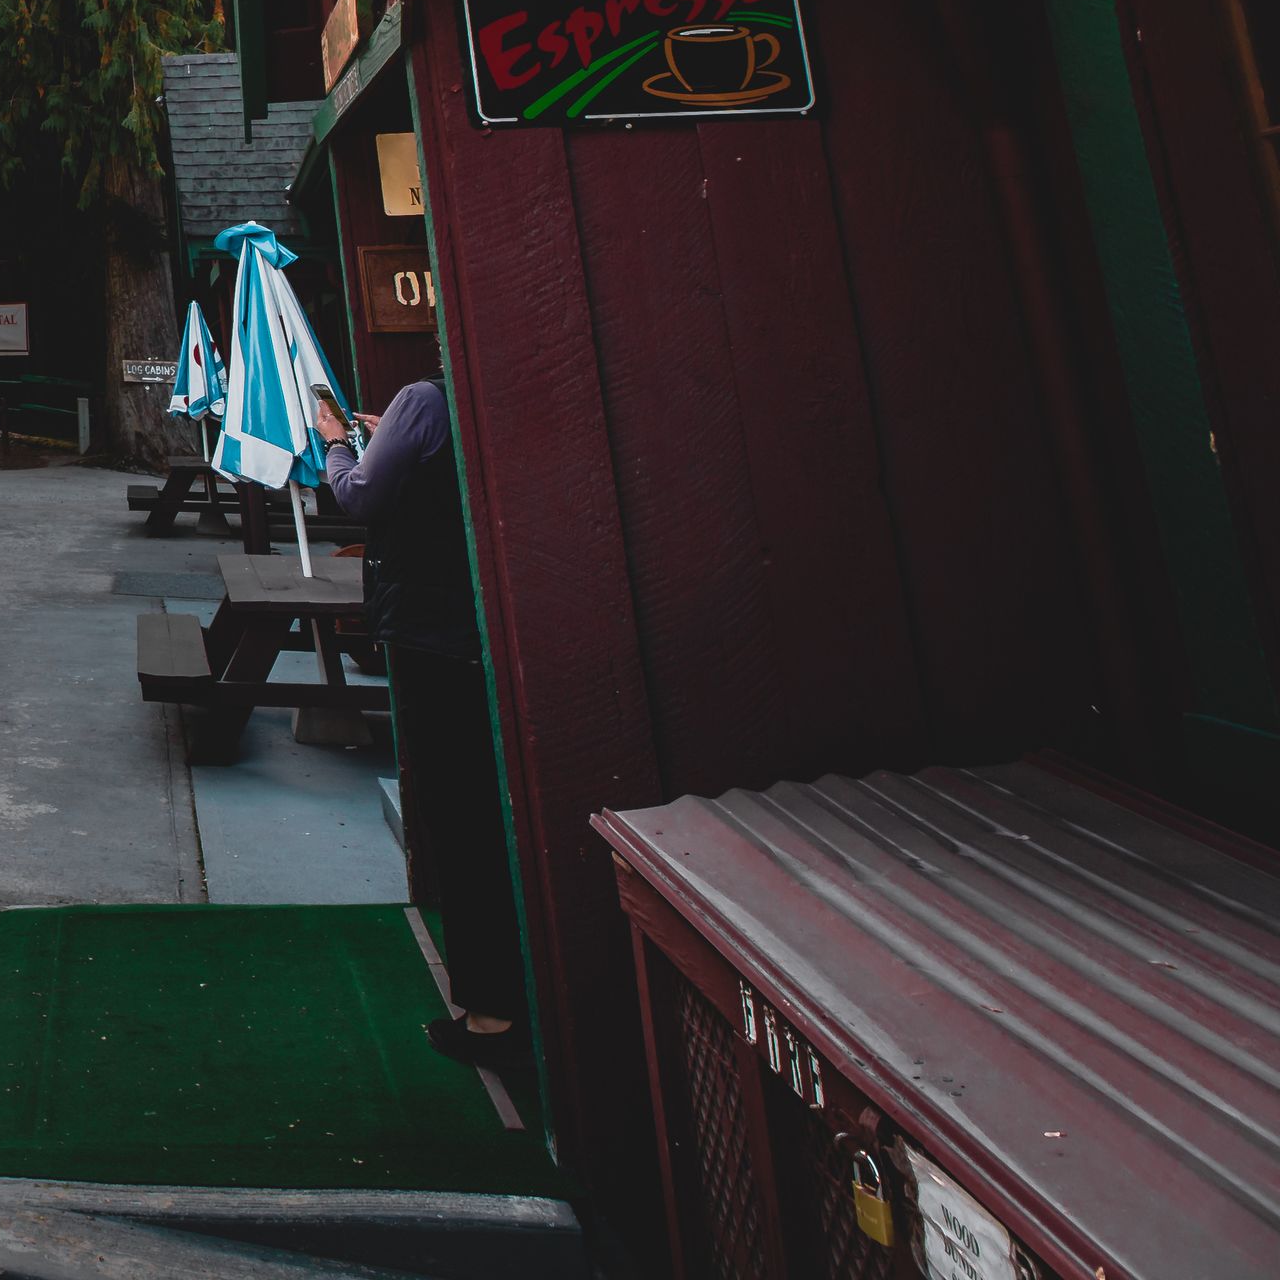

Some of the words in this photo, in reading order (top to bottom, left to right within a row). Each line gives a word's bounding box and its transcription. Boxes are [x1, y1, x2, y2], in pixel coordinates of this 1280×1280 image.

[126, 364, 143, 375] LOG
[145, 365, 176, 376] CABINS
[941, 1202, 980, 1258] WOOD
